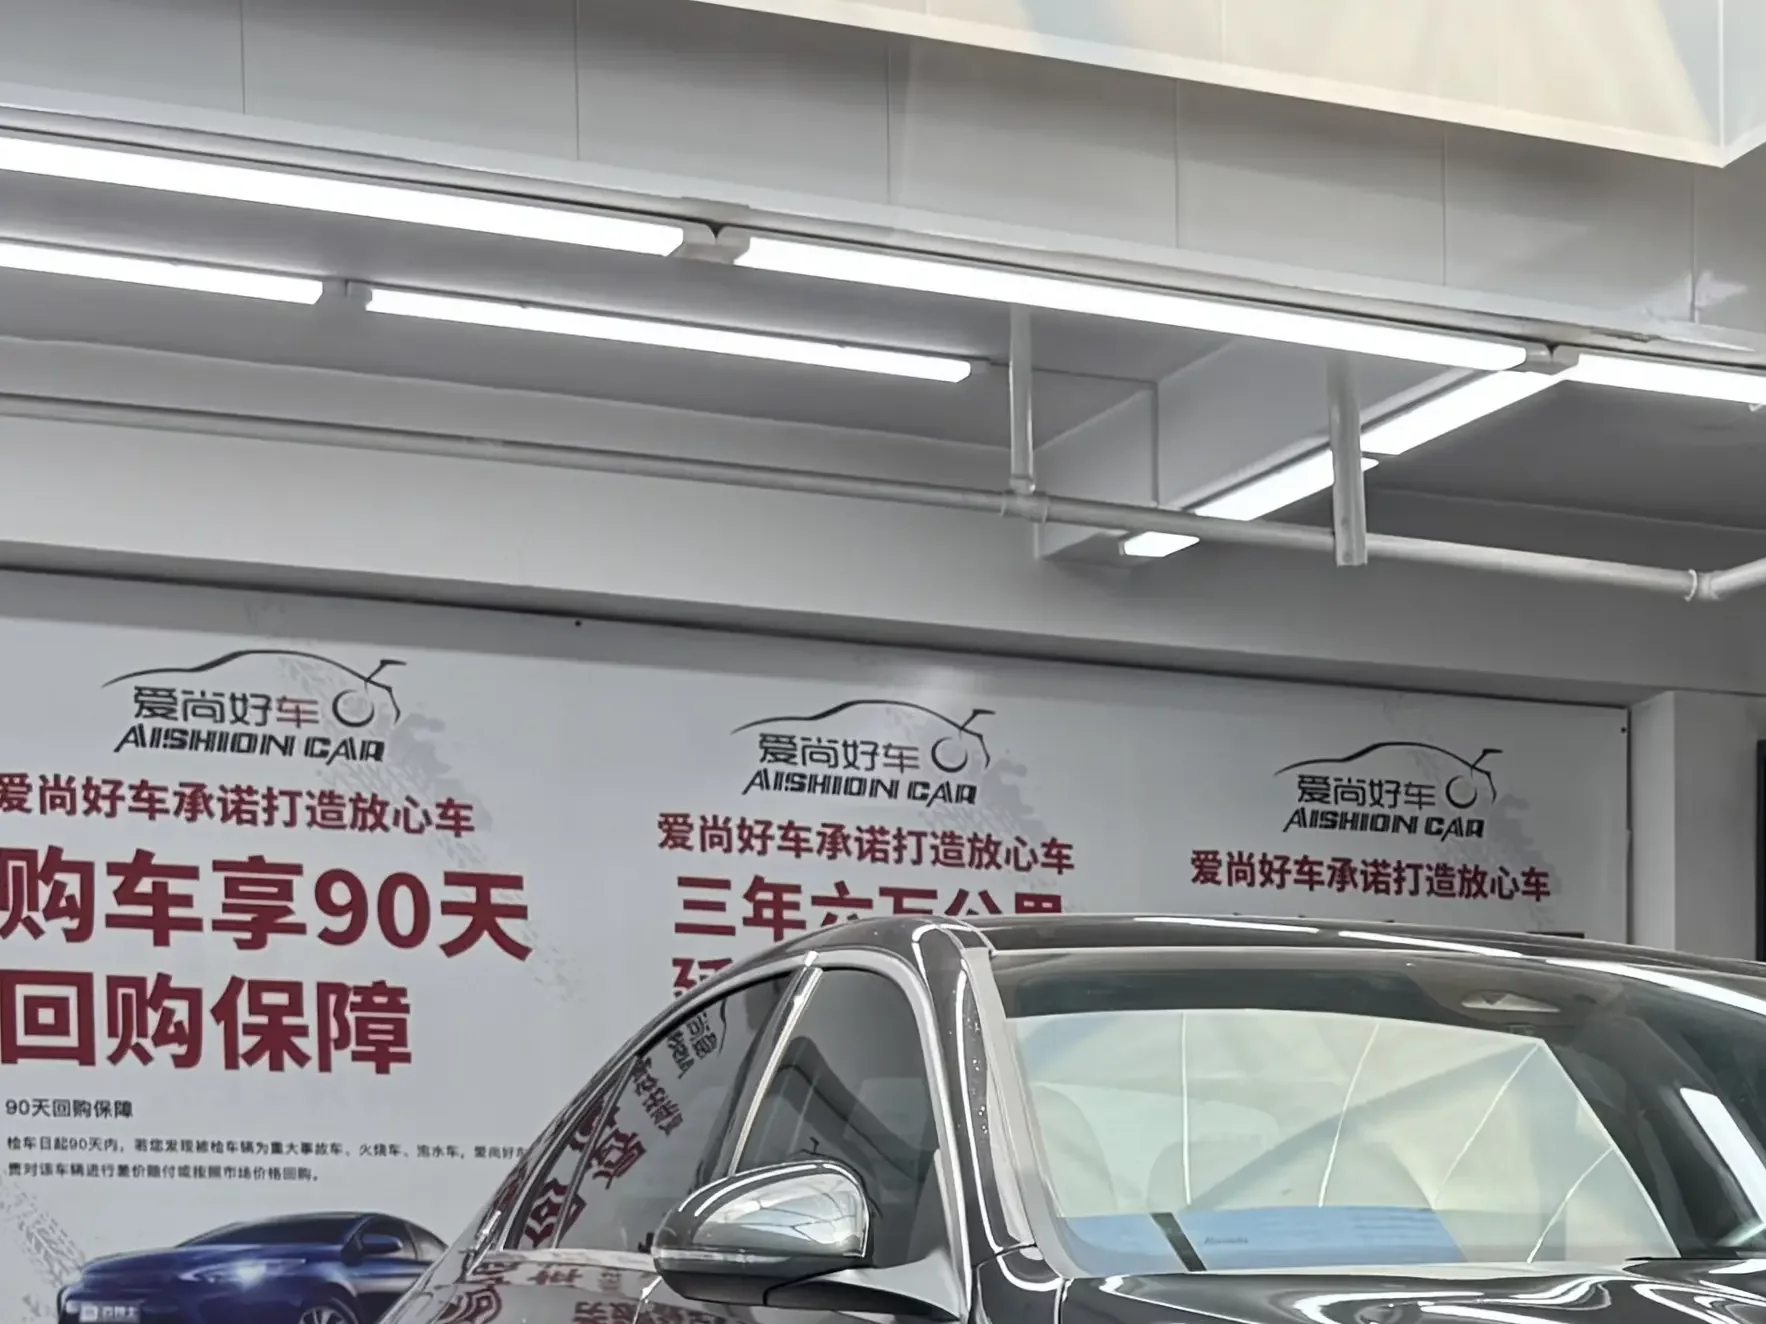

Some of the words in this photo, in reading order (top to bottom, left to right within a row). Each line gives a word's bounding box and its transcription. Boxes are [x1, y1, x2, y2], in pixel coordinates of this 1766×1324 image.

[133, 686, 320, 728] 爱尚好车
[302, 735, 387, 766] CAR
[757, 733, 921, 774] 爱尚好车
[0, 772, 476, 838] 爱尚好车承诺打造放心车
[905, 779, 978, 807] CAR
[1296, 774, 1436, 810] 爱尚好车
[656, 812, 1076, 875] 爱尚好车承诺打造放心车
[1423, 814, 1486, 843] CAR
[1189, 849, 1552, 902] 爱尚好车承诺打造放心车
[0, 845, 533, 962] 购车享90天
[0, 968, 412, 1075] 回购保障
[5, 1098, 134, 1119] 90天回购保障
